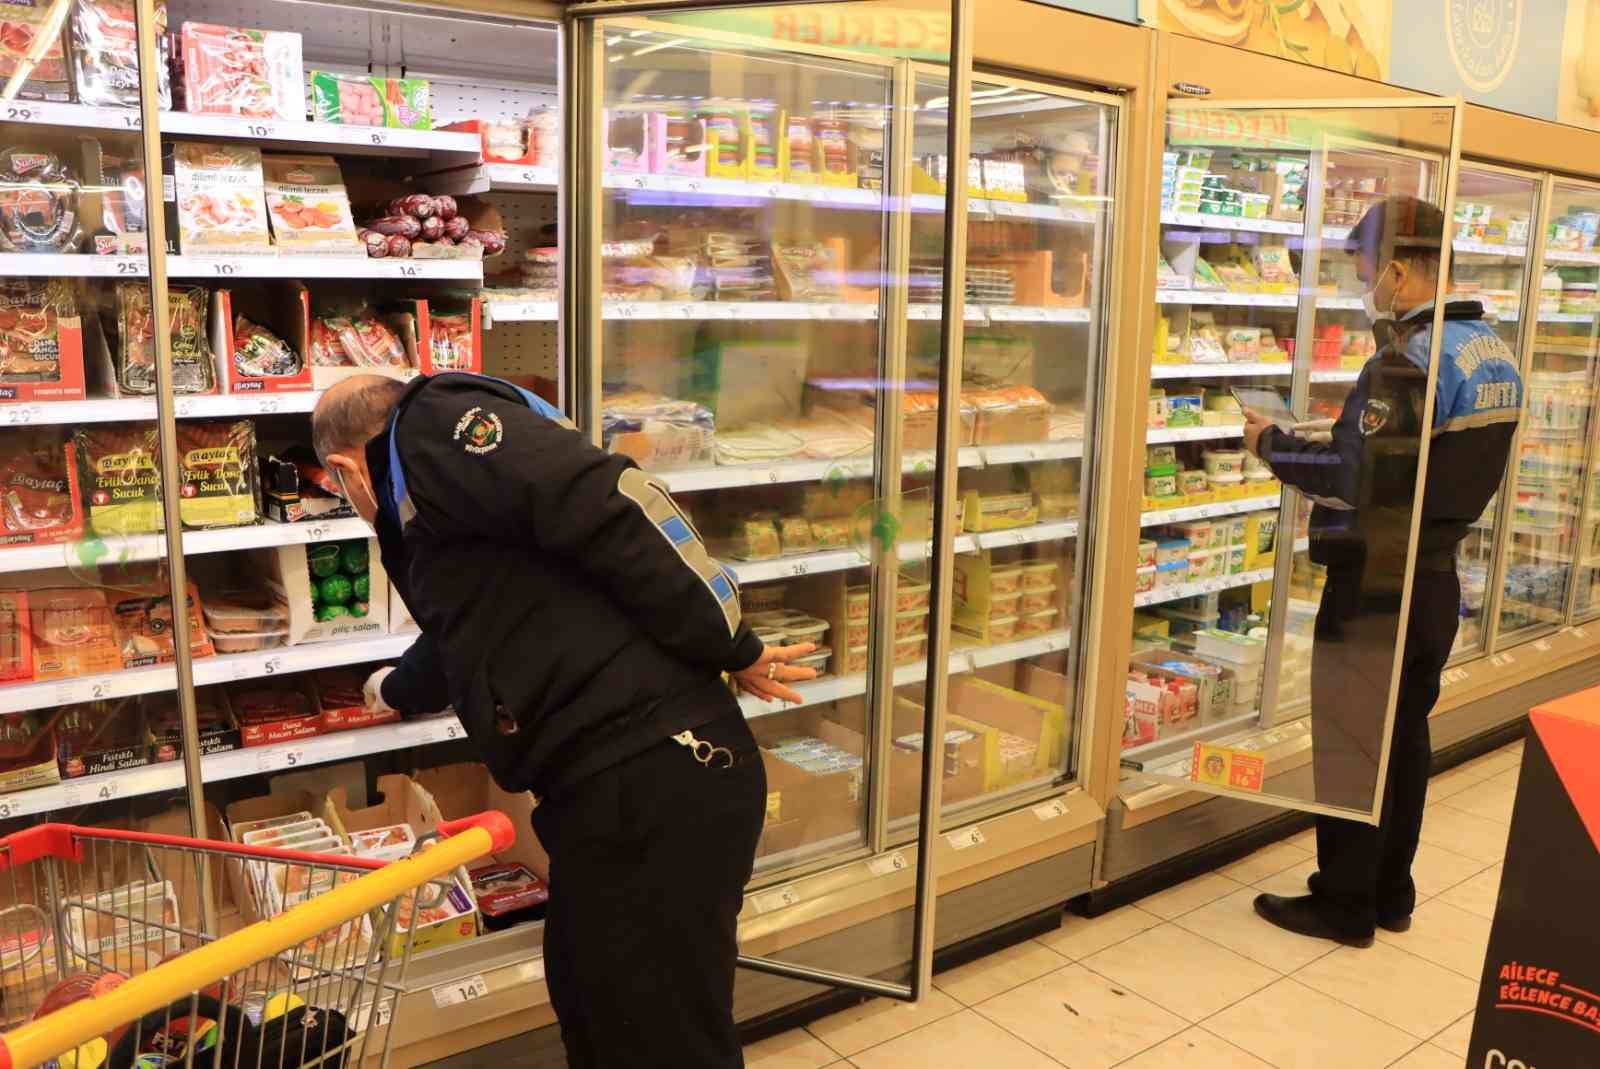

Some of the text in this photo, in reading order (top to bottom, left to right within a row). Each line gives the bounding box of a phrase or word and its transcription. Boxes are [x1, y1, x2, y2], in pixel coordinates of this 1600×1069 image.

[112, 487, 145, 500] Sucuk
[1499, 960, 1560, 986] AİLECE
[459, 985, 478, 1001] 14
[1499, 981, 1600, 1026] EĞLENCE BA
